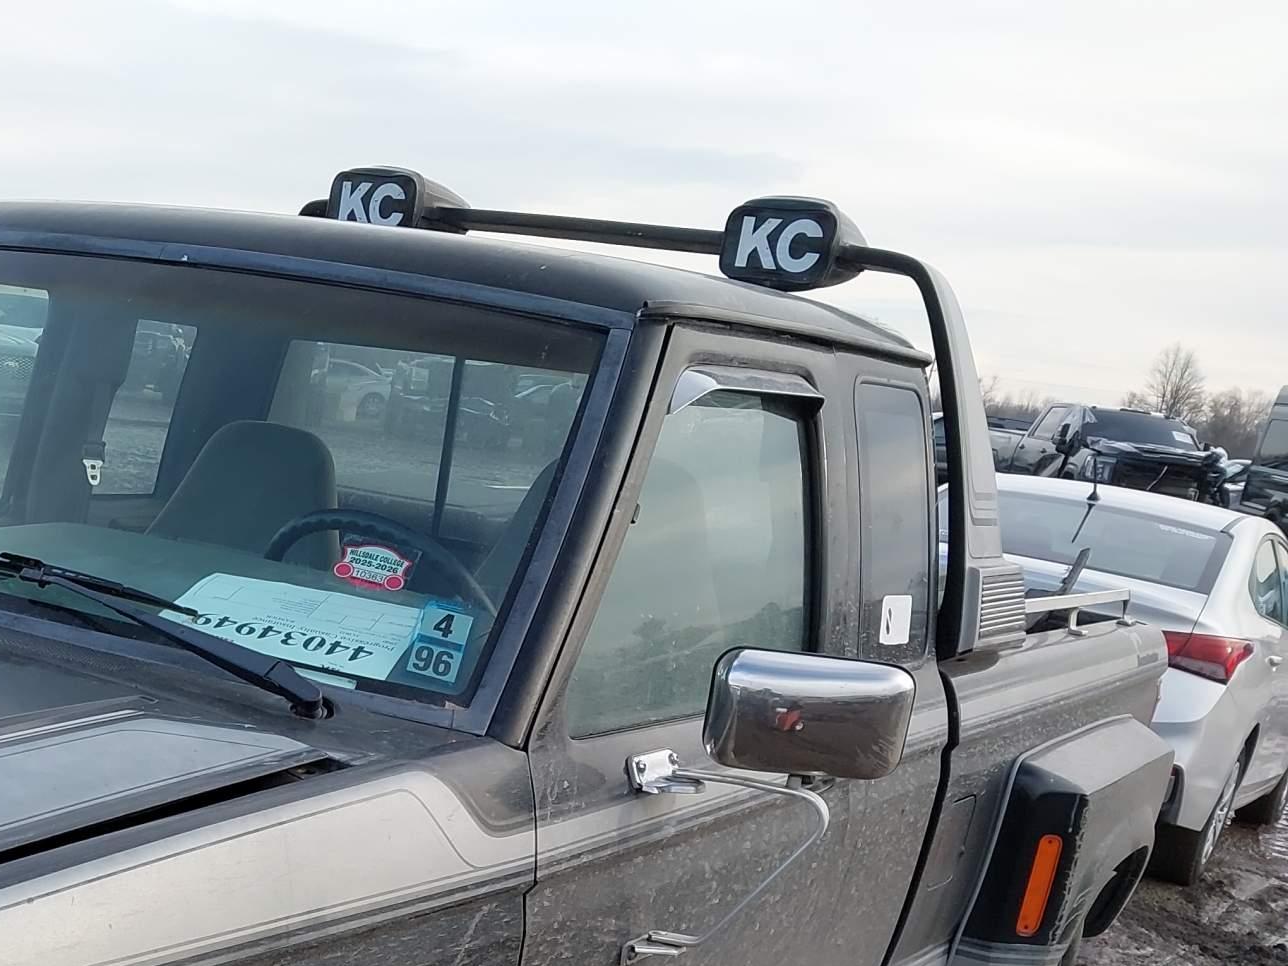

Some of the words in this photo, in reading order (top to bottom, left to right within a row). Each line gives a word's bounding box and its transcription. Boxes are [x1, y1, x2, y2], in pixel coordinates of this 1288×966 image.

[336, 181, 406, 228] KC
[734, 215, 825, 273] KC
[349, 549, 380, 562] HILLSDALE
[380, 555, 405, 569] COLLEGE
[349, 556, 399, 574] 2025-2026
[354, 569, 384, 583] 10363
[196, 613, 374, 662] 44034949
[432, 613, 456, 639] 4
[412, 645, 454, 677] 96
